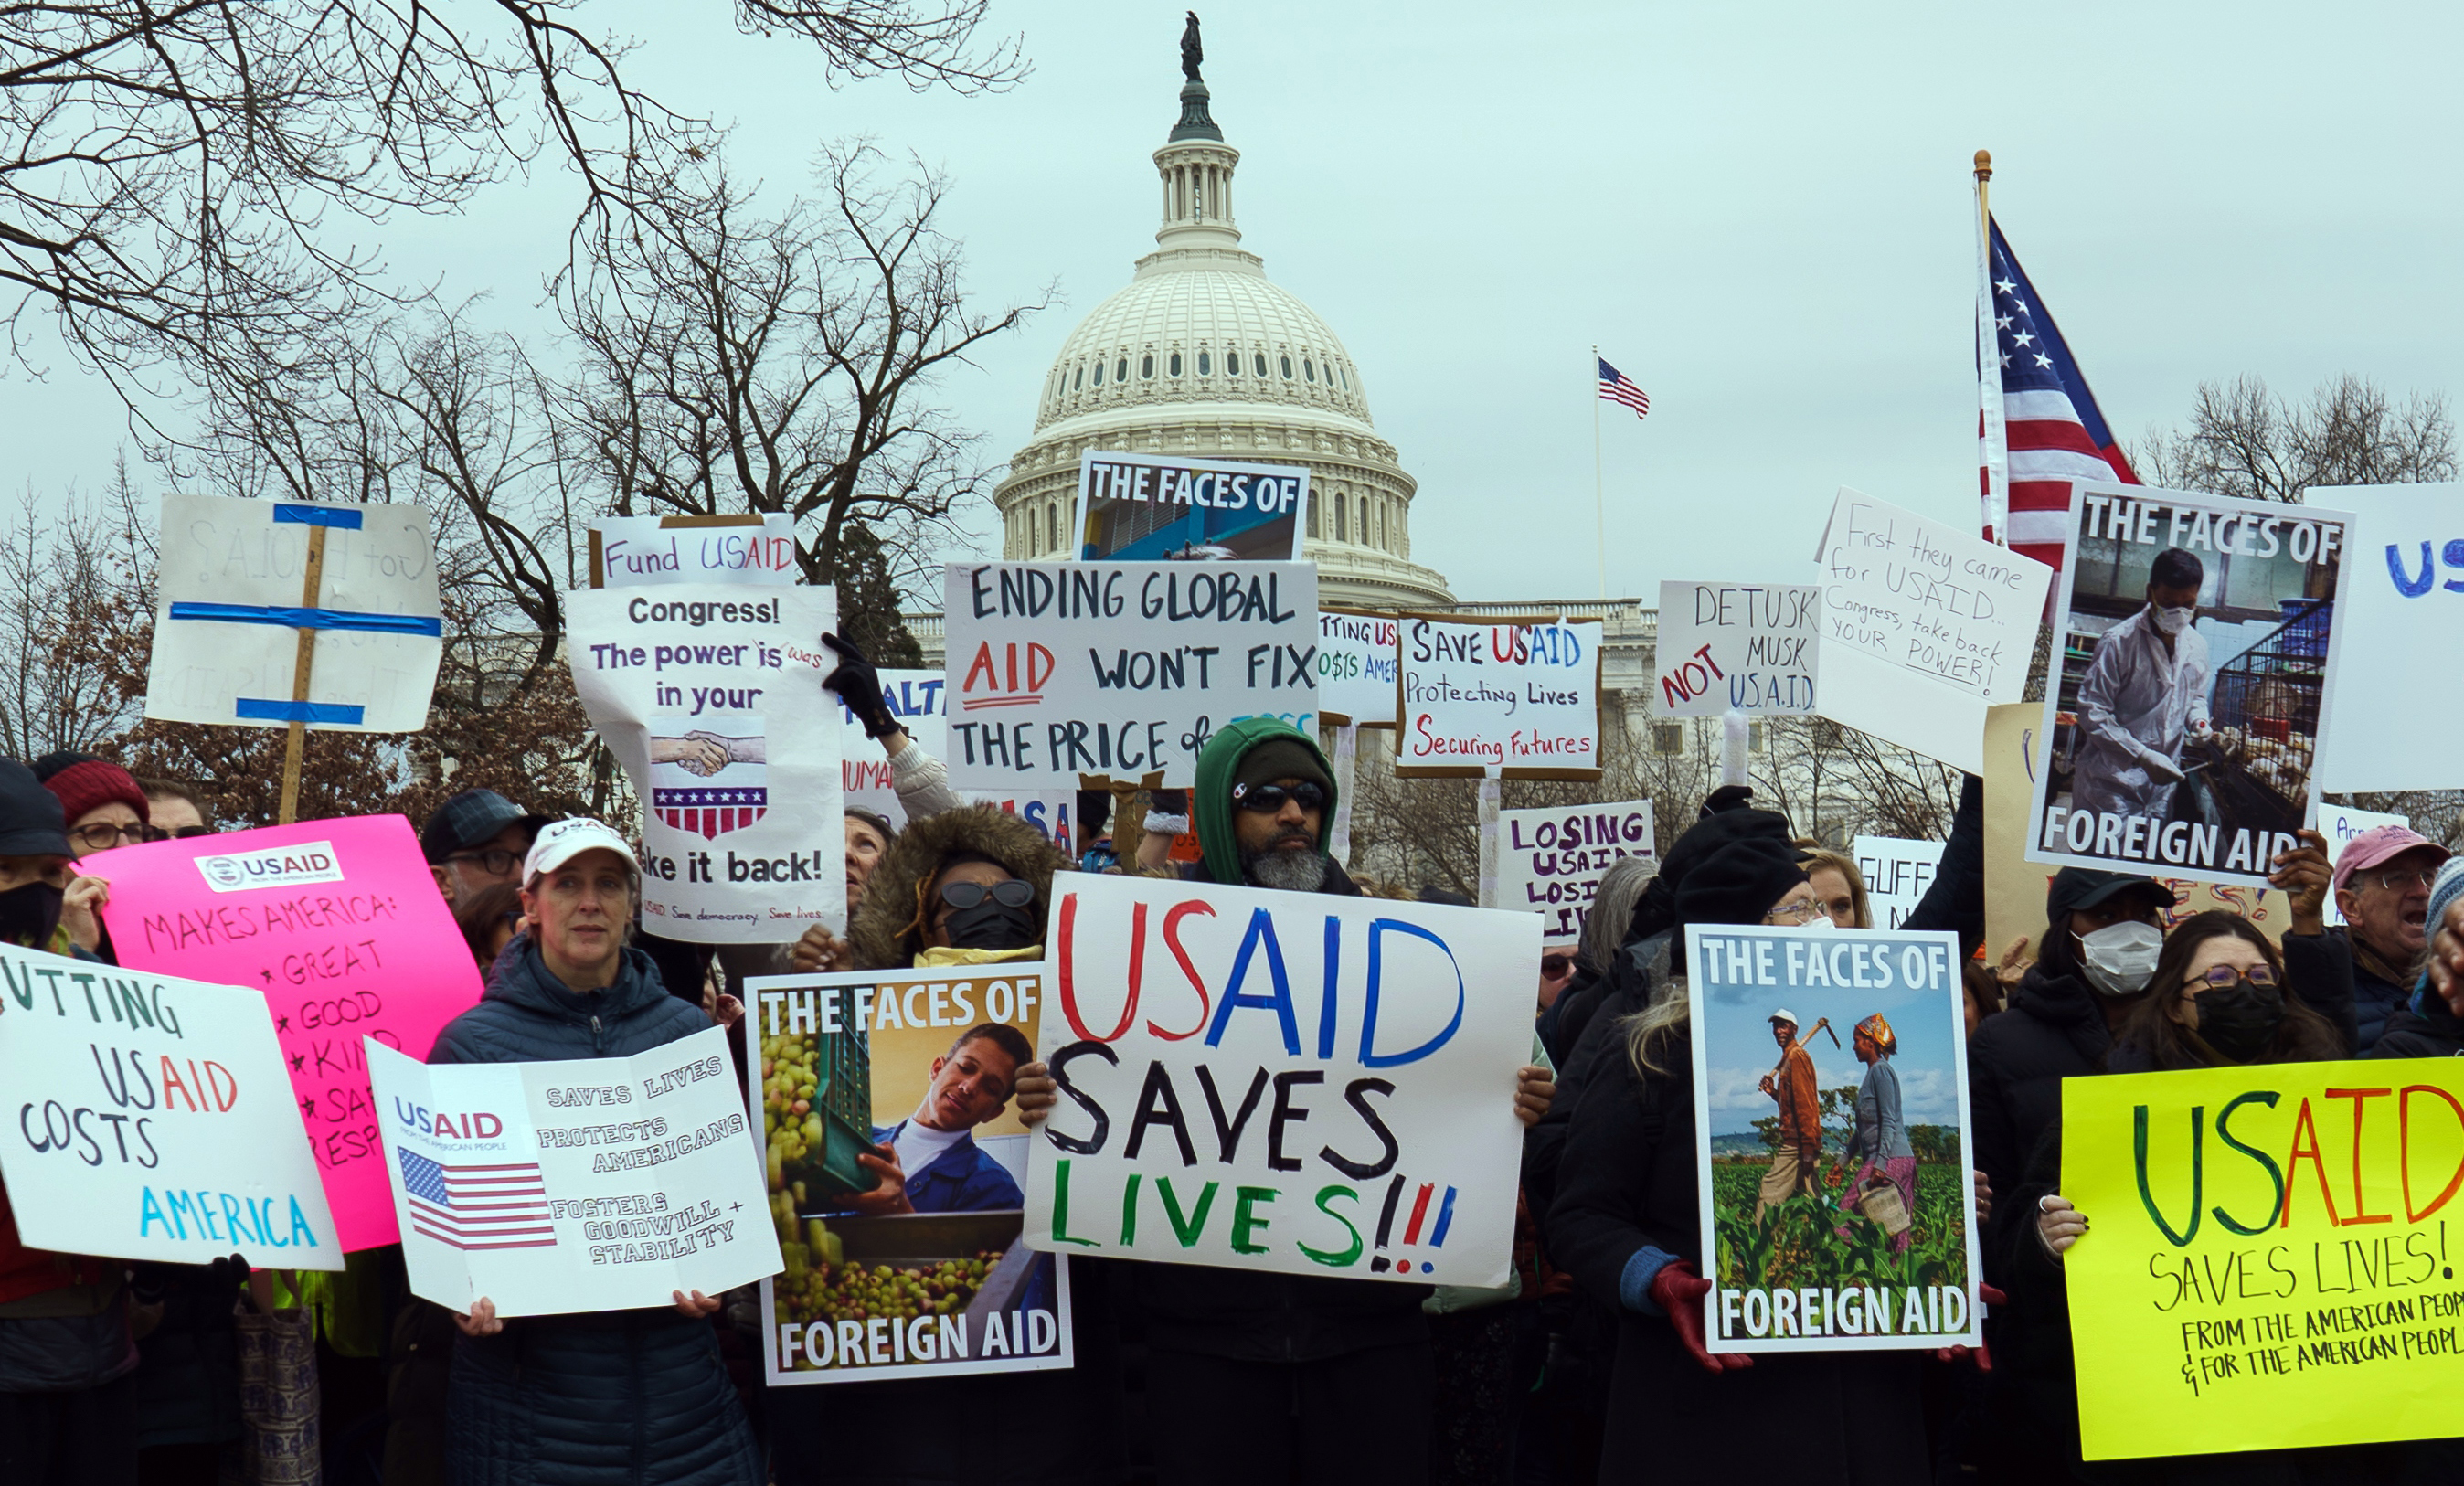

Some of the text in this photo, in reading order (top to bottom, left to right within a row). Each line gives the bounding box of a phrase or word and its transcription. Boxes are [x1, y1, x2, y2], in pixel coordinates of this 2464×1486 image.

[1092, 463, 1297, 514] THE FACES OF
[1848, 503, 2023, 590] First they came
[2083, 494, 2342, 565] THE FACES OF
[604, 536, 793, 578] Fund USAID
[1831, 547, 1870, 581] for
[628, 597, 780, 627] Congress!
[971, 565, 1295, 624] ENDING GLOBAL
[1412, 620, 1582, 668] SAVE USAID
[1825, 585, 2002, 666] Congress, take back
[590, 643, 646, 670] The
[655, 644, 748, 671] power
[788, 646, 823, 669] was
[963, 641, 1316, 693] AID WON'T FIX
[1318, 650, 1359, 682] O$TS
[1661, 643, 1726, 708] NOT
[1747, 636, 1808, 672] MUSK
[1832, 616, 1994, 697] YOUR POWER!
[656, 682, 764, 716] in your
[1407, 671, 1579, 716] Protecting Lives
[951, 722, 1035, 771] THE
[1049, 720, 1167, 773] PRICE
[1413, 713, 1590, 765] Securing Futures
[1511, 812, 1643, 851] LOSING
[2043, 805, 2299, 875] FOREIGN AID
[242, 854, 330, 876] USAID
[640, 846, 822, 883] ake it back!
[1860, 856, 1938, 897] SUFF
[769, 907, 791, 920] Save
[1526, 880, 1599, 904] LOSI
[143, 893, 398, 953] MAKES AMERICA:
[282, 939, 382, 986] GREAT
[1058, 892, 1464, 1067] USAID
[1702, 939, 1946, 990] THE FACES OF
[0, 956, 183, 1039] UTTING
[300, 991, 382, 1029] GOOD
[760, 979, 1036, 1035] THE FACES OF
[91, 1043, 237, 1112] USAID
[547, 1056, 723, 1108] SAVES LIVES
[325, 1086, 377, 1123] SA
[394, 1096, 503, 1139] USAID
[1044, 1040, 1399, 1181] SAVES
[20, 1099, 159, 1169] COSTS
[307, 1125, 377, 1170] RESP
[474, 1141, 507, 1151] PEOPLE
[537, 1116, 668, 1149] PROTECTS
[593, 1113, 745, 1173] AMERICANS
[2134, 1085, 2464, 1247] USAID
[140, 1185, 318, 1248] AMERICA
[551, 1192, 669, 1219] FOSTERS
[583, 1199, 721, 1241] GOODWILL
[1052, 1159, 1458, 1274] LIVES!!!
[589, 1219, 735, 1265] STABILITY
[2149, 1220, 2453, 1312] SAVES LIVES!
[1721, 1285, 1968, 1338] FOREIGN AID
[2182, 1291, 2464, 1353] FROM THE AMERICAN PEOP
[781, 1308, 1057, 1369] FOREIGN AID
[2182, 1326, 2464, 1397] & FOR THE AMERICAN PEOPL
